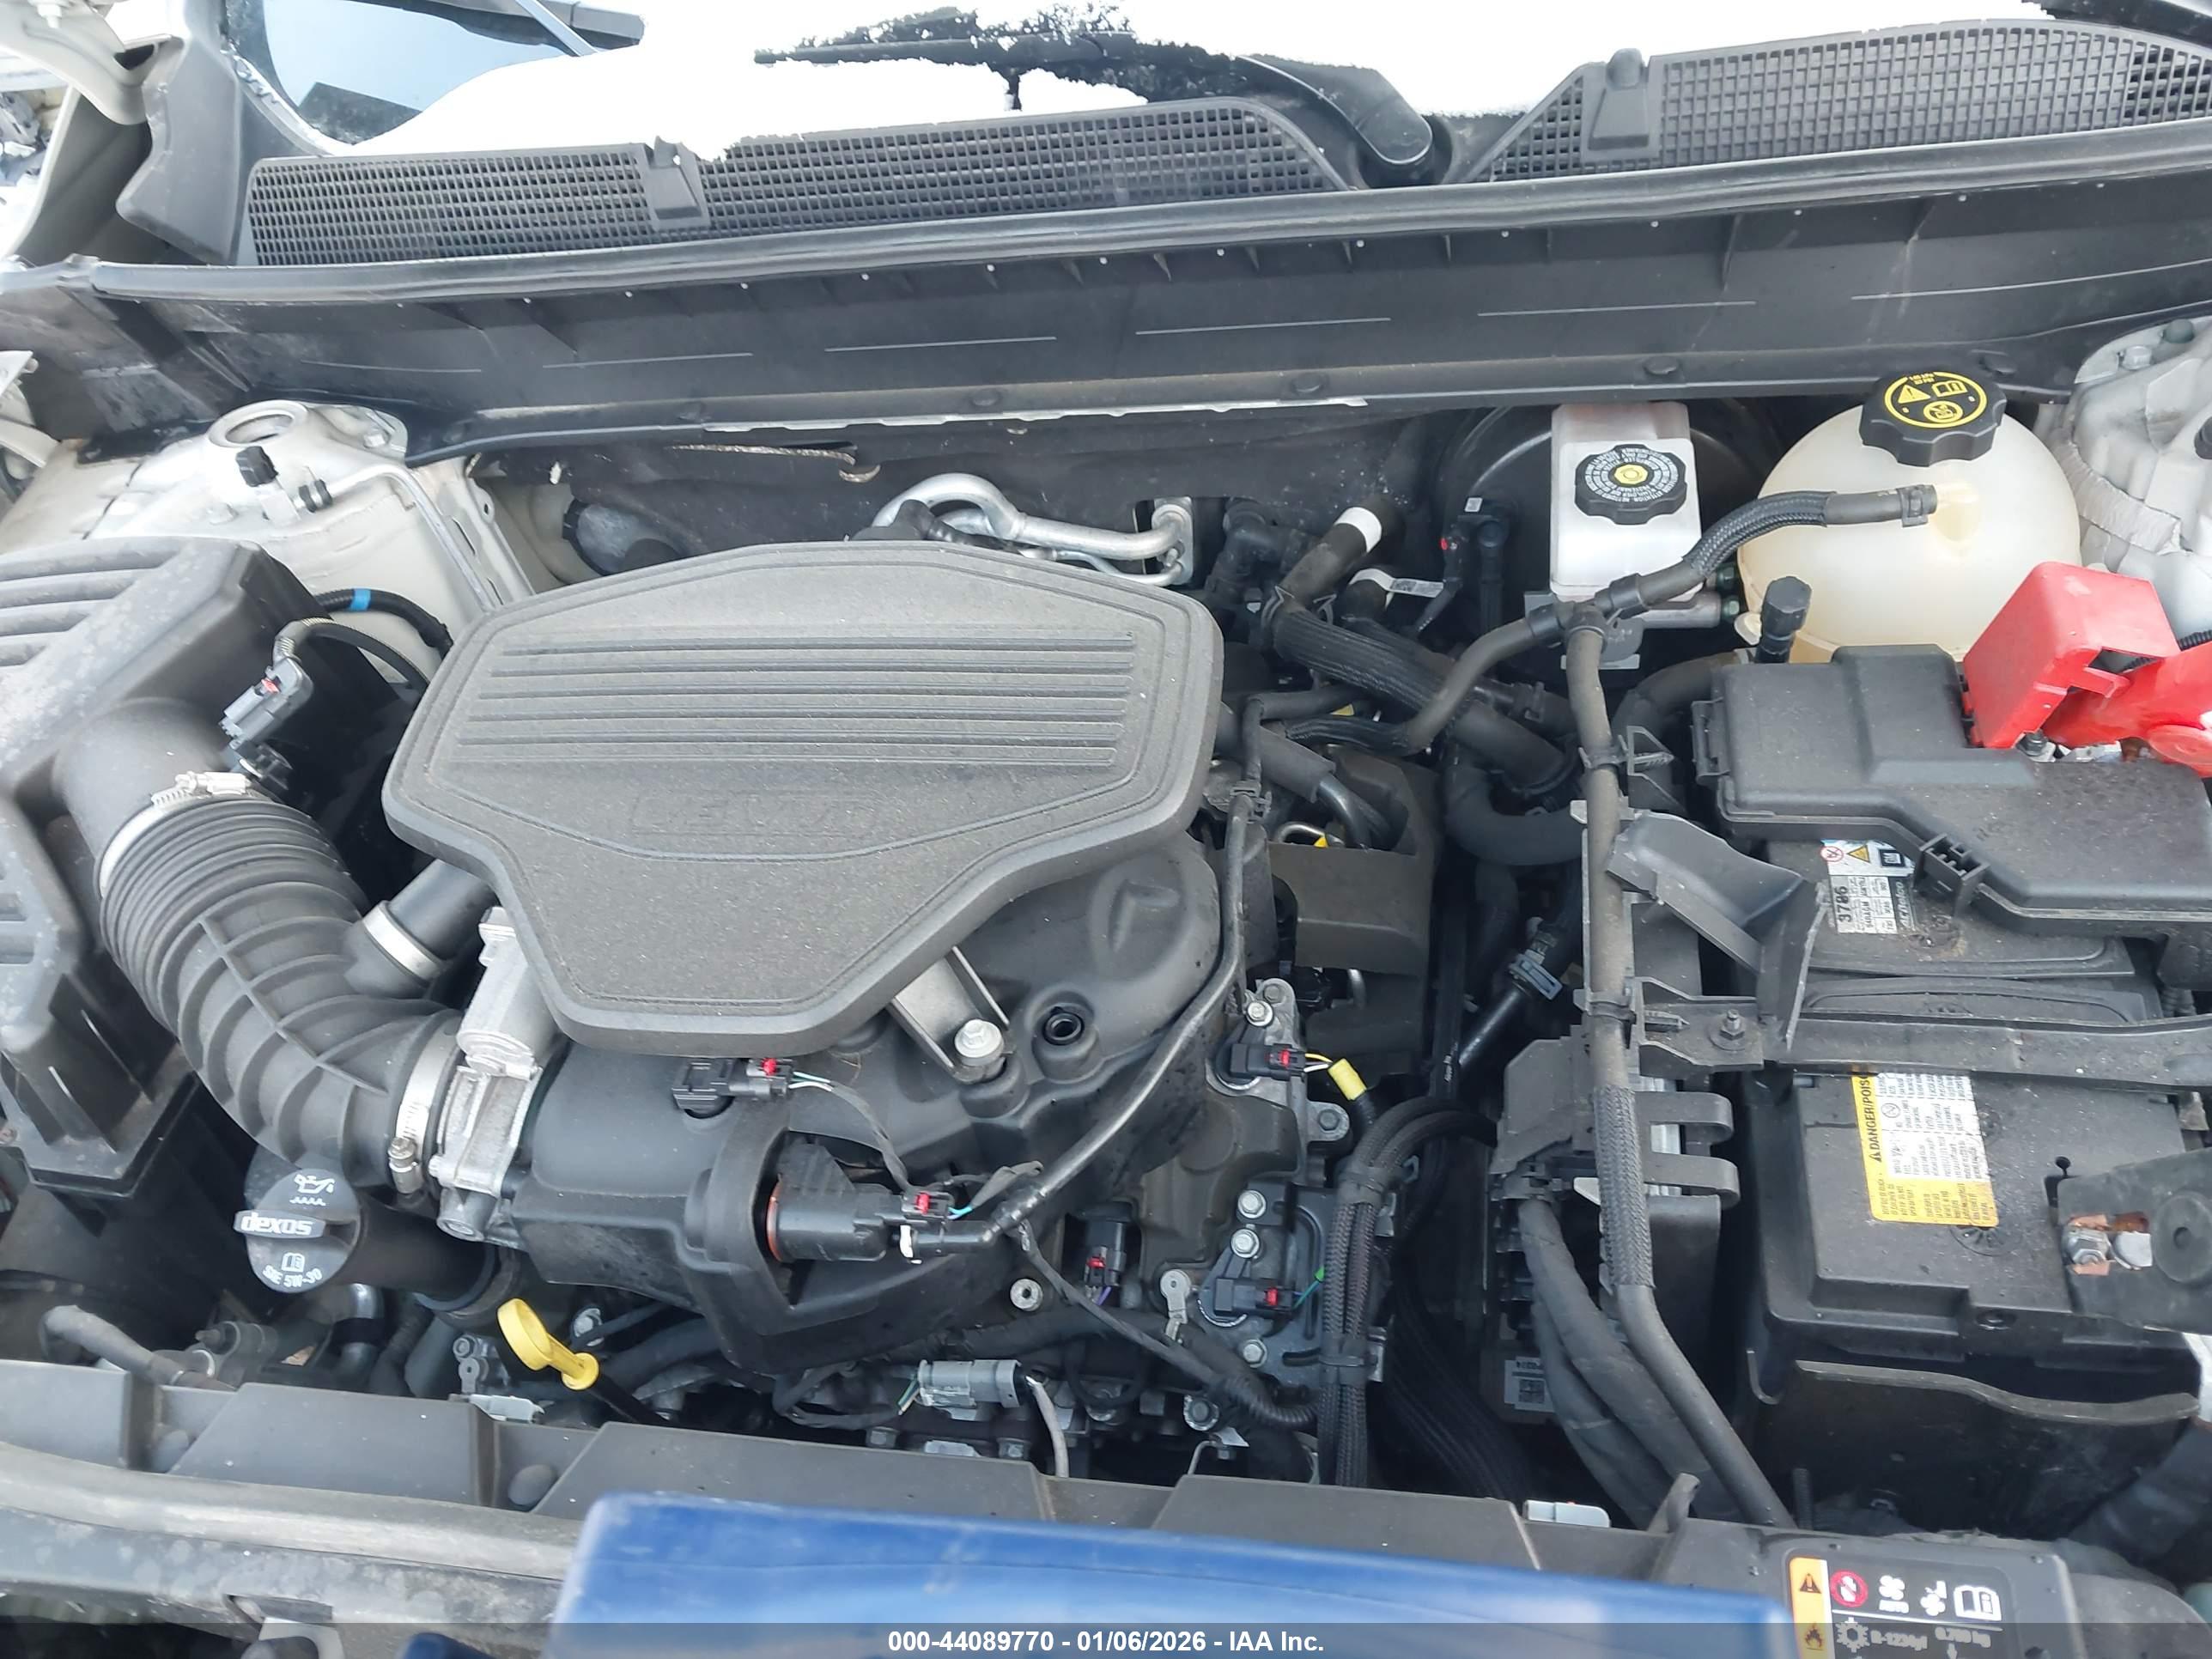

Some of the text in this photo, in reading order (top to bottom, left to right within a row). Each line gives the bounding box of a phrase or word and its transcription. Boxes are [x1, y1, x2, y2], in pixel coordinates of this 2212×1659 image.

[1883, 852, 1902, 865] GM
[1895, 881, 1911, 928] ACDelco
[240, 1212, 313, 1236] dexos
[283, 1267, 322, 1287] 5W-30
